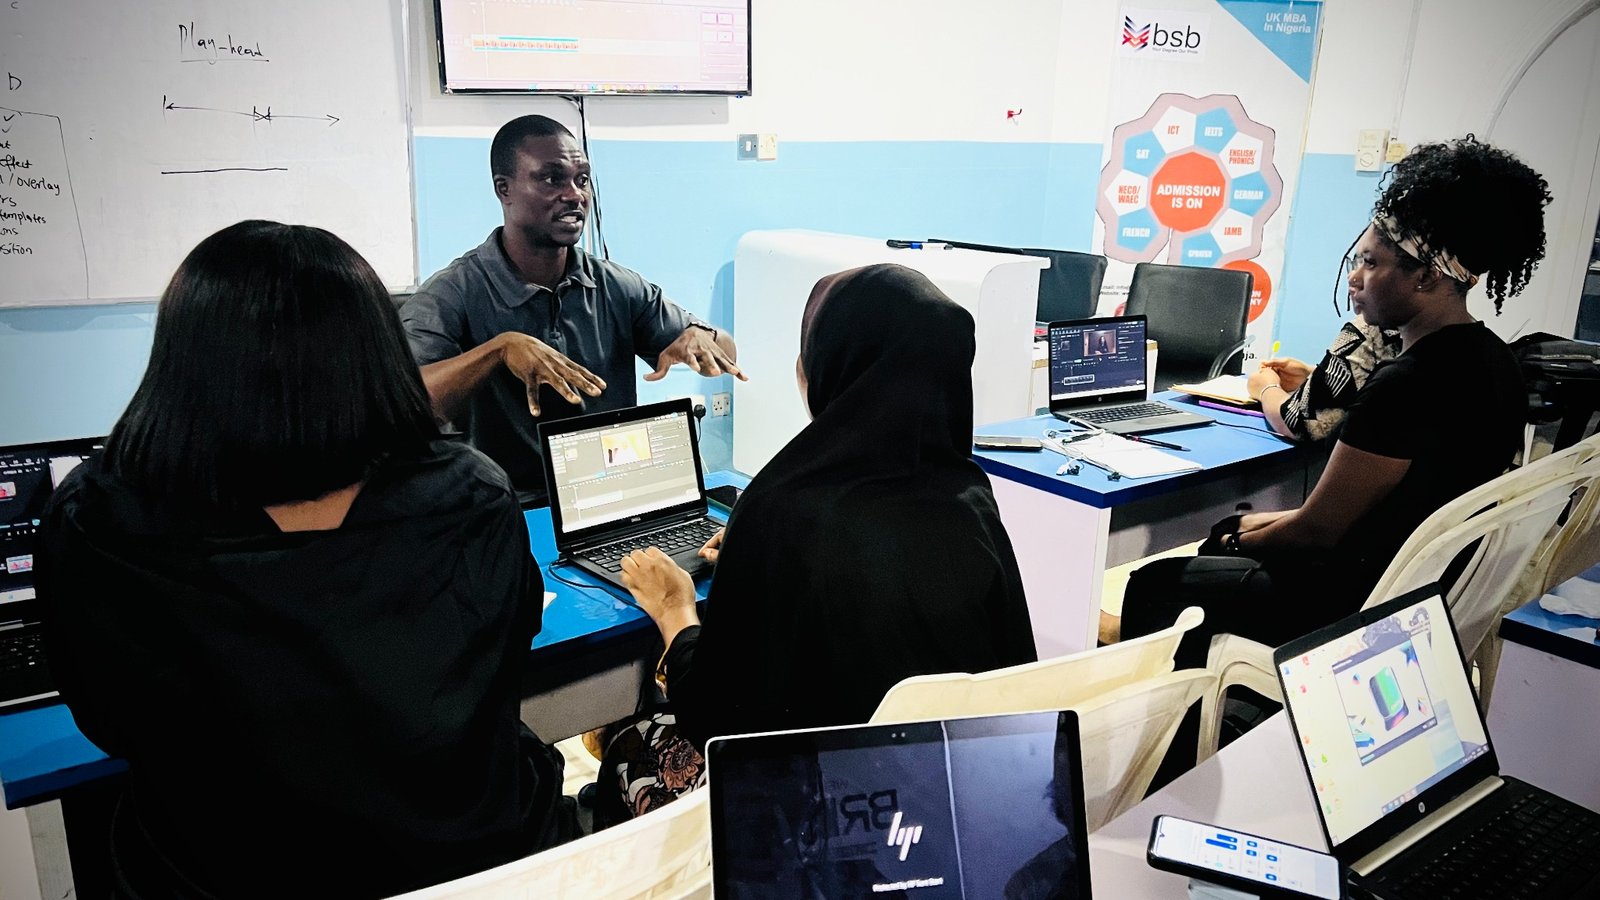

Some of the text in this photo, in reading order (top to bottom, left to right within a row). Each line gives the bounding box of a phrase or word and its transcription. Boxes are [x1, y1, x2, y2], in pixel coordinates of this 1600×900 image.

[1266, 13, 1307, 23] UK MBA
[1264, 22, 1311, 35] In Nigeria
[1152, 23, 1201, 49] bsb
[7, 72, 22, 91] D
[1167, 125, 1180, 135] ICT
[1136, 149, 1150, 159] SAT
[1228, 157, 1255, 165] PHONICS
[1118, 185, 1141, 194] NECO/
[1156, 184, 1221, 197] ADMISSION
[1118, 194, 1139, 204] WAEC
[1171, 197, 1203, 209] IS ON
